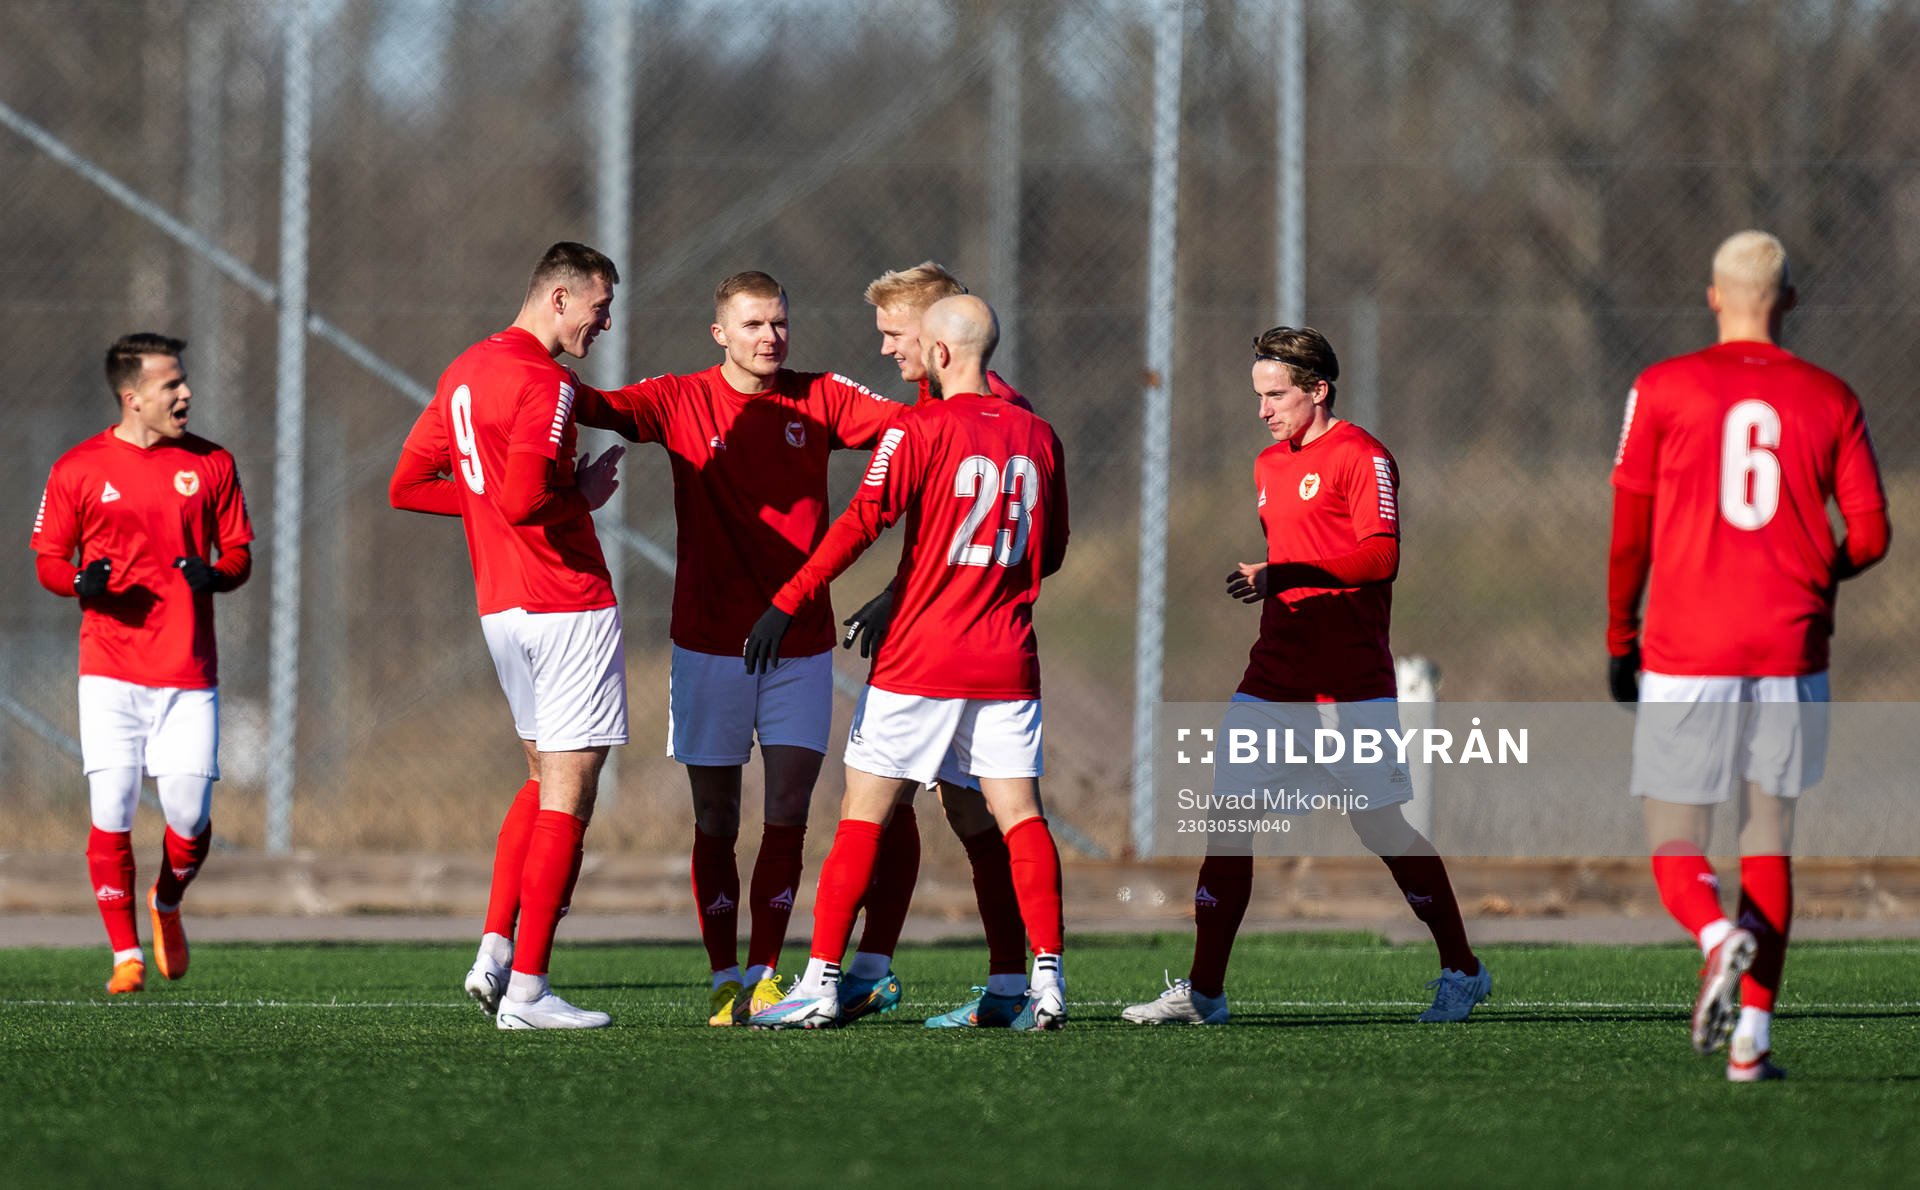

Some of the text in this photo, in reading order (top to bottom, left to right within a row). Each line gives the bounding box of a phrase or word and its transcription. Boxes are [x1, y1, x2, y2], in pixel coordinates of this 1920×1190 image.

[450, 384, 485, 495] 9
[1720, 399, 1781, 531] 6
[947, 454, 1039, 568] 23
